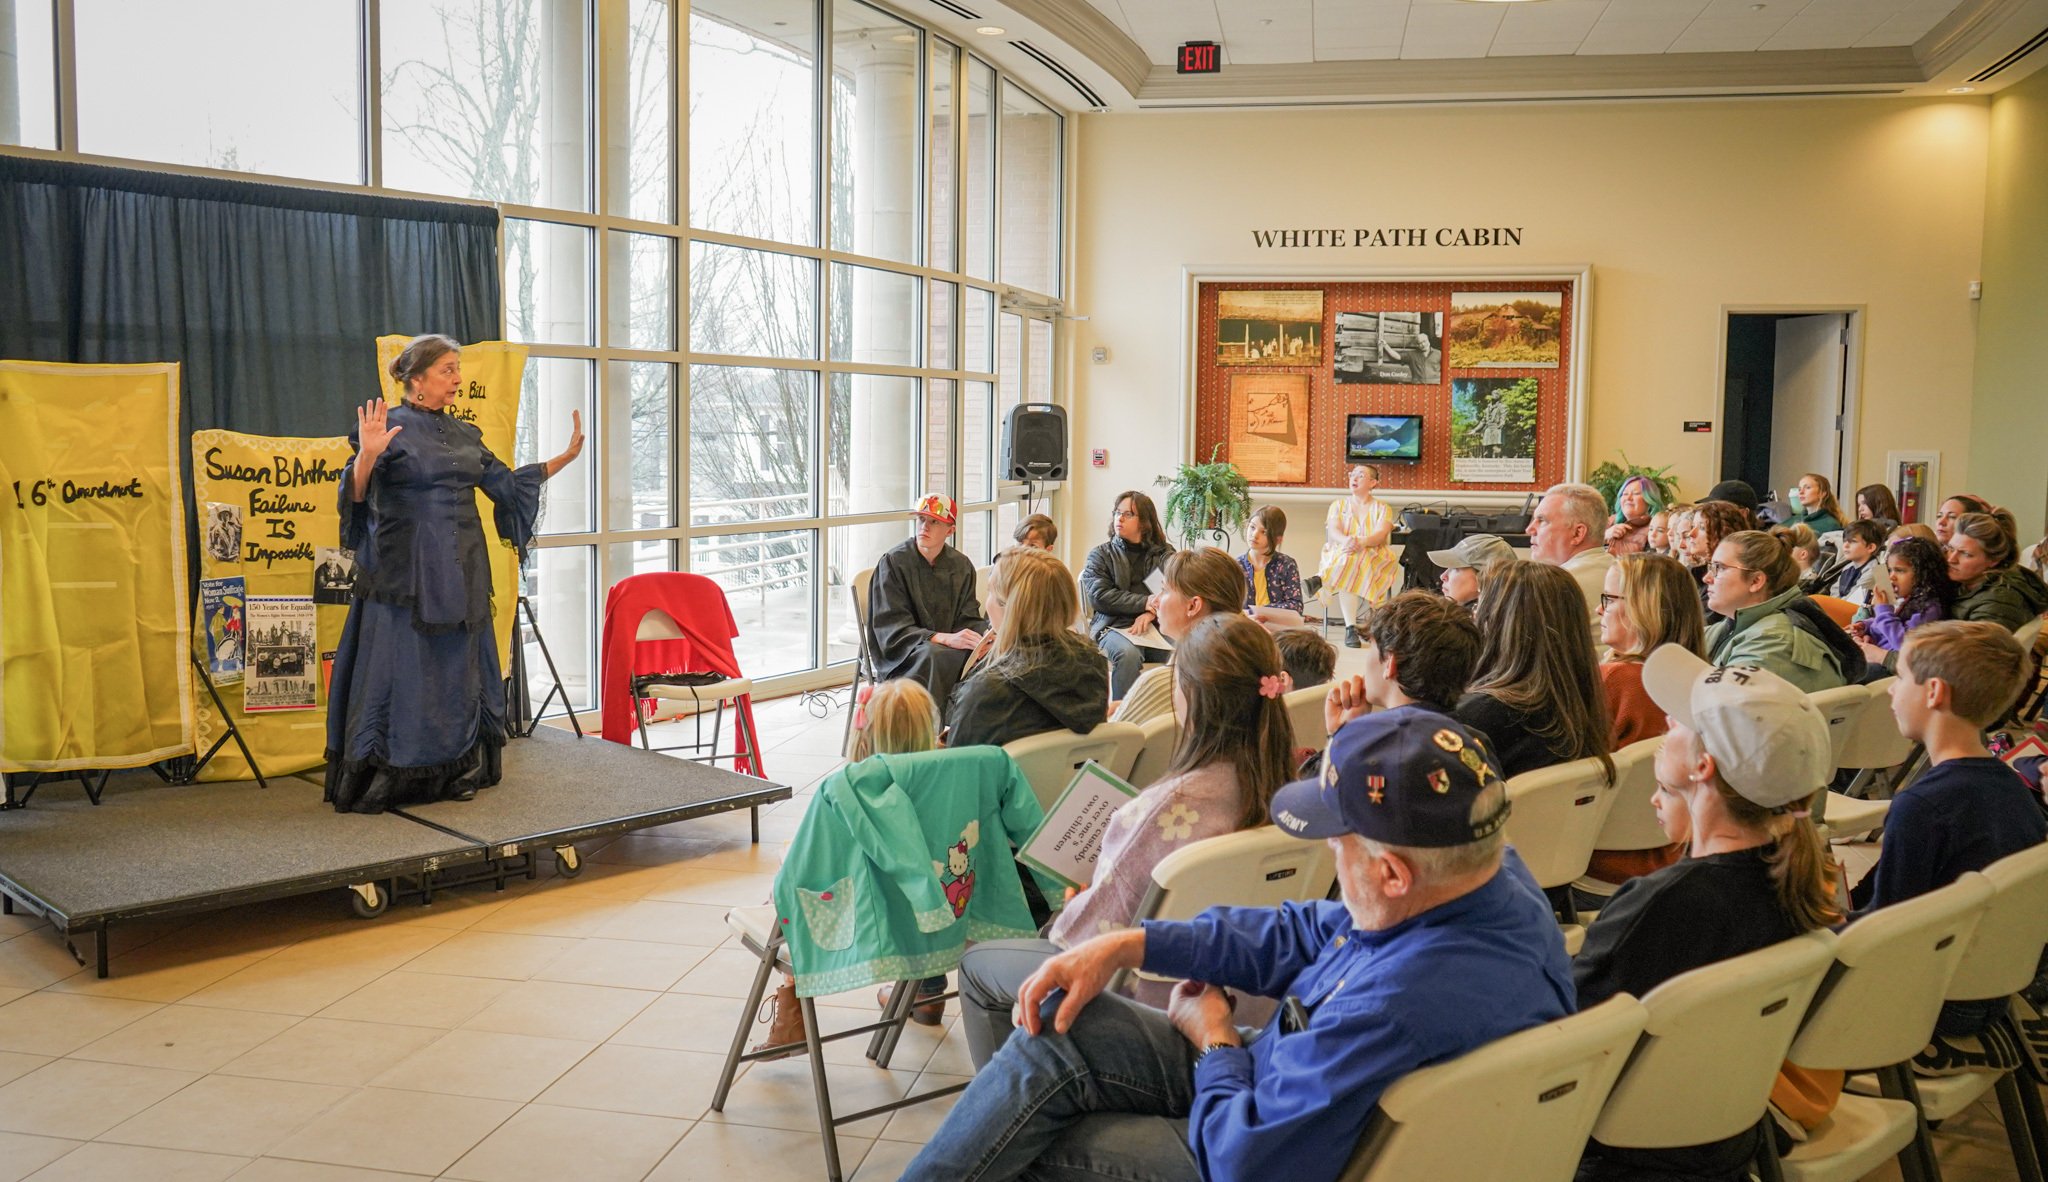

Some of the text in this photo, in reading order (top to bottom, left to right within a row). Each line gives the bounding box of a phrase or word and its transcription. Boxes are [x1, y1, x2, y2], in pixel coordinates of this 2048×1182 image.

[1185, 46, 1216, 70] EXIT
[1252, 227, 1524, 248] WHITE PATH CABIN
[469, 380, 486, 399] Bill
[205, 447, 271, 484] Susan
[292, 457, 344, 488] Anthon
[249, 488, 316, 517] Failure
[266, 518, 295, 539] IS
[245, 542, 315, 569] Impossible
[203, 584, 244, 597] Woman Suffrage
[262, 603, 279, 611] Years
[281, 603, 289, 611] for
[291, 603, 314, 612] Equality
[1092, 801, 1109, 821] over
[1278, 810, 1309, 832] ARMY
[1054, 794, 1099, 852] own children
[1073, 822, 1093, 847] one's
[1074, 828, 1102, 863] custody
